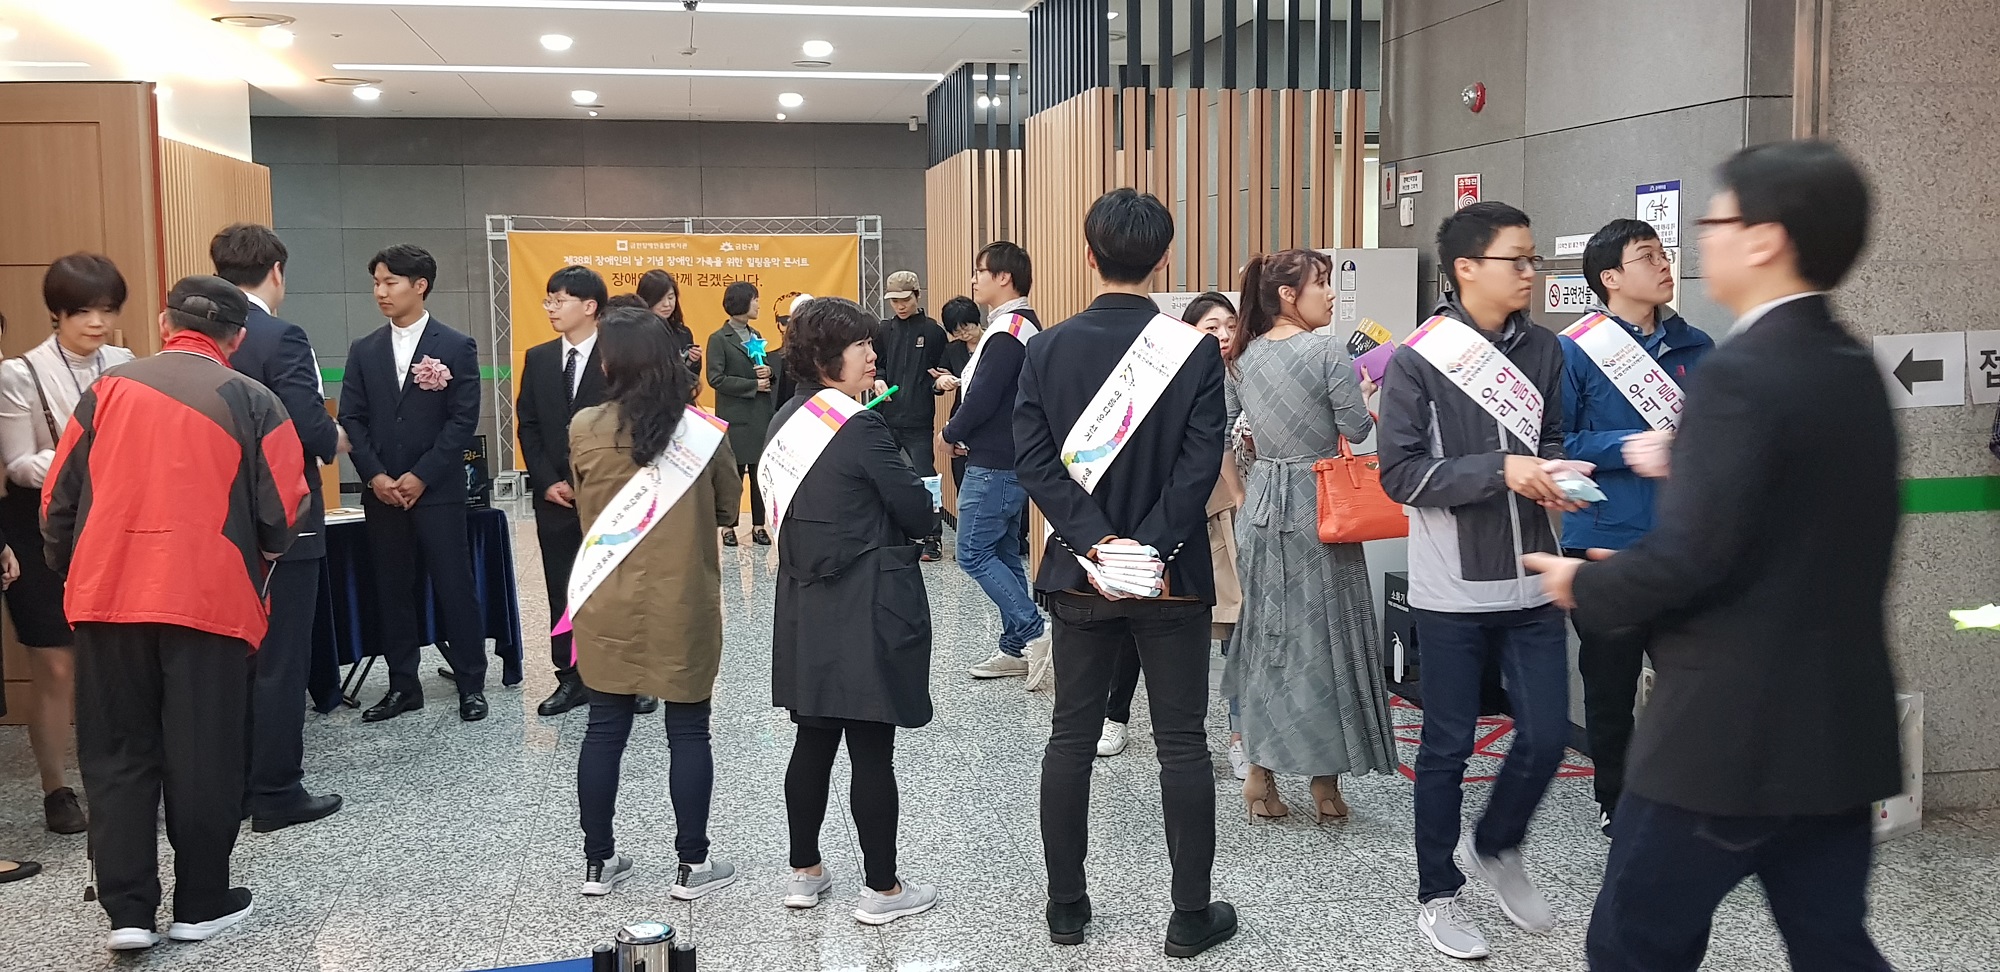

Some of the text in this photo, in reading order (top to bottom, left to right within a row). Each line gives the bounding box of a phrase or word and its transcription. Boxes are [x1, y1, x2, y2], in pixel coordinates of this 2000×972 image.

[1458, 178, 1476, 186] 소화전
[563, 255, 809, 267] 제38회 장애인의 날 기념 장애인 가족을 위한 힐링음악 콘서트
[1562, 285, 1592, 304] 금연건물
[1481, 387, 1518, 417] 우리
[1629, 384, 1661, 413] 우리
